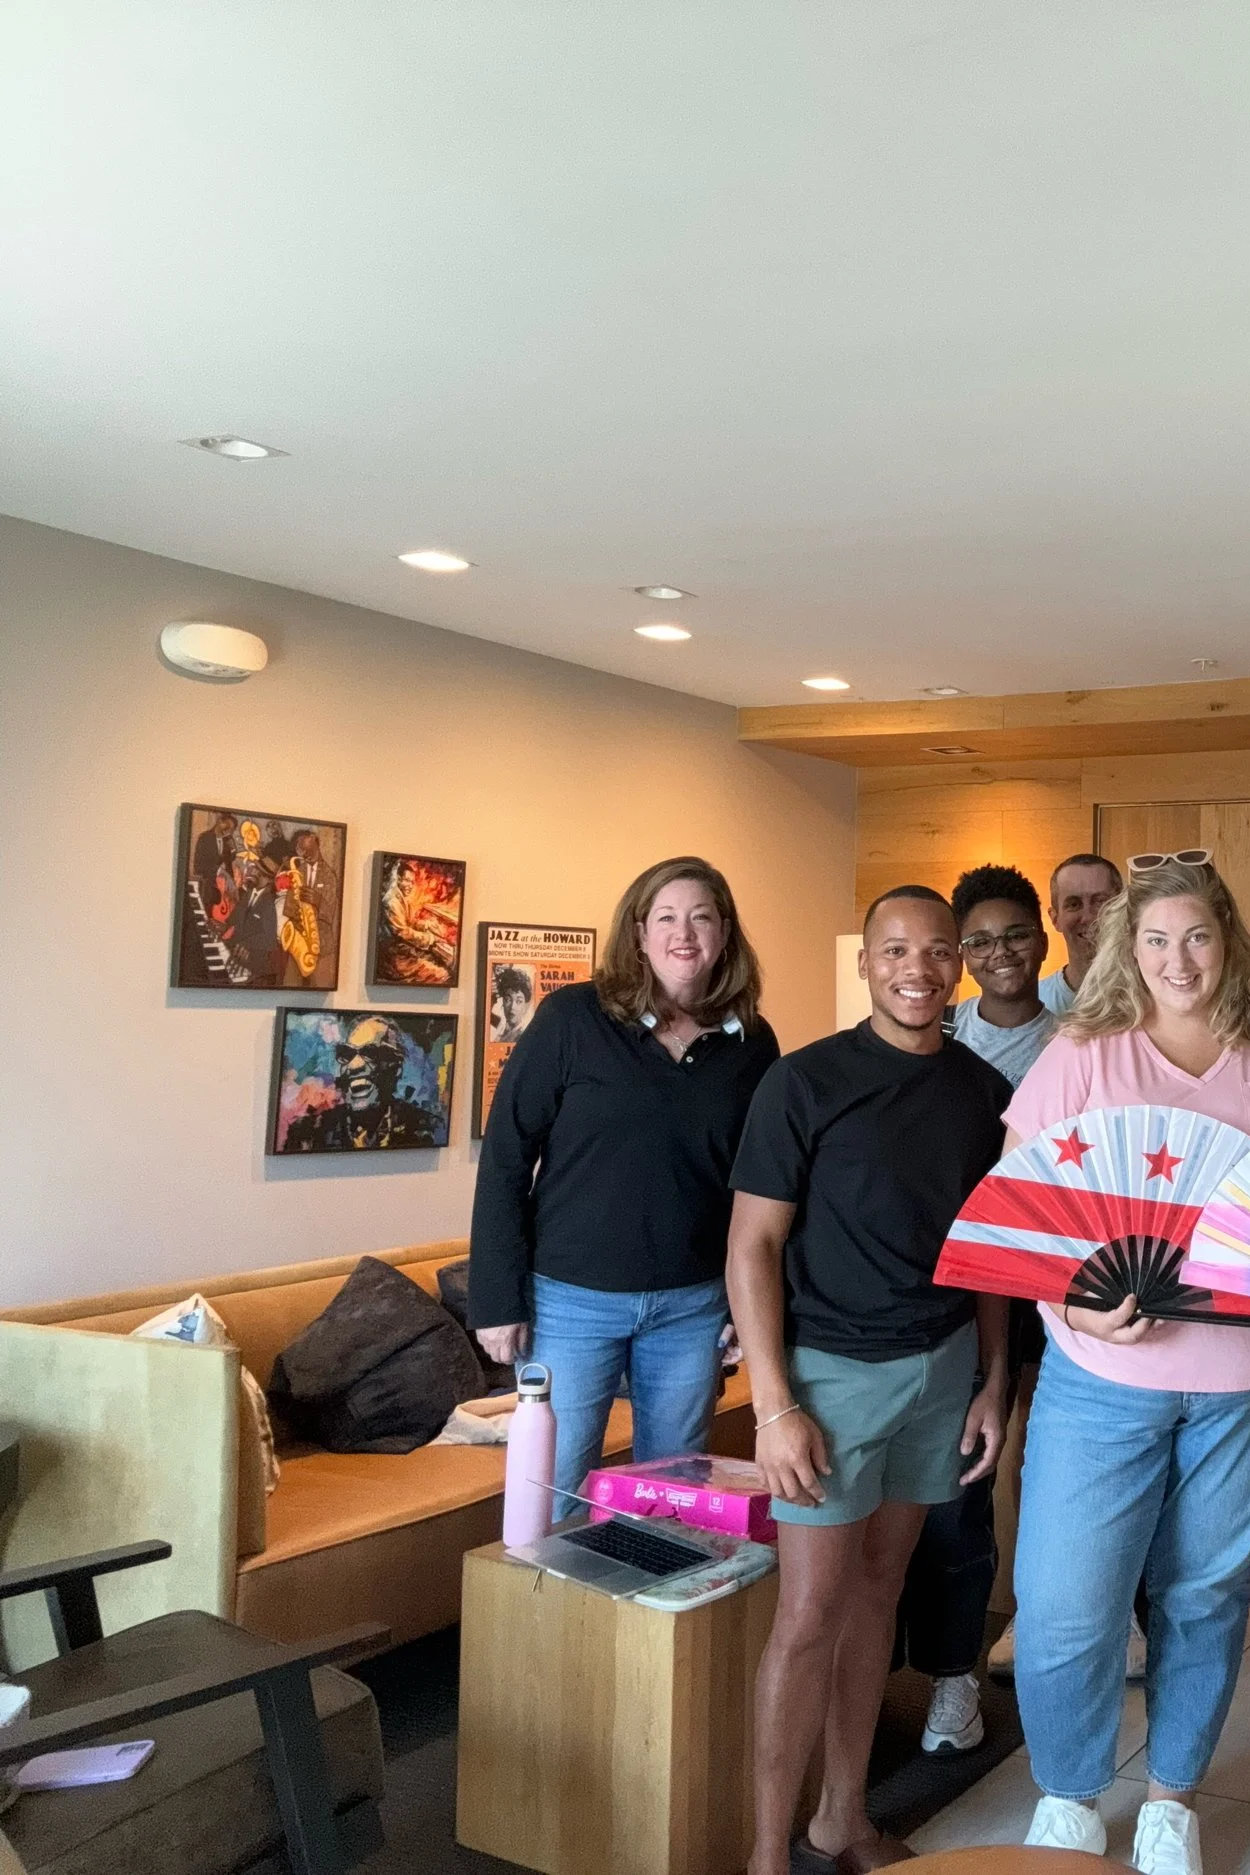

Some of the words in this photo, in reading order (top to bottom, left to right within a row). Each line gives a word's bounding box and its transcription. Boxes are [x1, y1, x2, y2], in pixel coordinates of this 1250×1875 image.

[490, 930, 519, 941] JAZZ
[544, 933, 590, 944] HOWARD
[540, 971, 574, 981] SARAH
